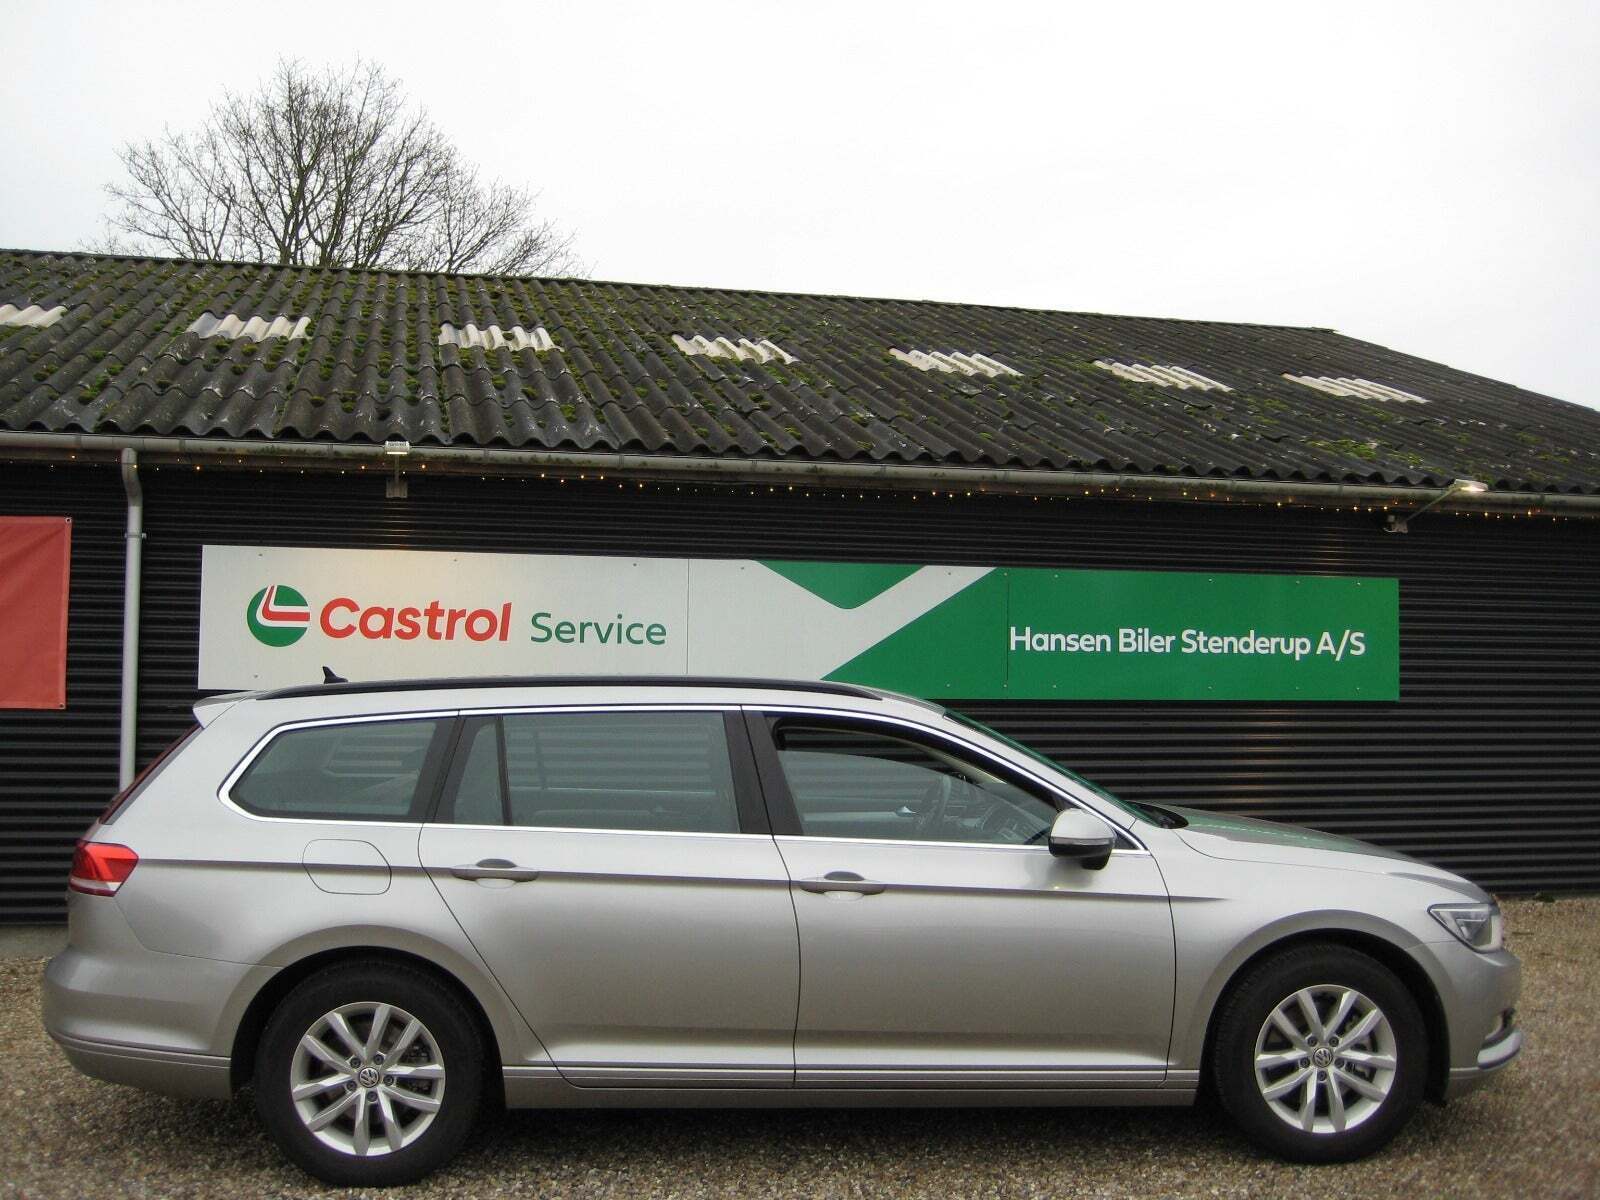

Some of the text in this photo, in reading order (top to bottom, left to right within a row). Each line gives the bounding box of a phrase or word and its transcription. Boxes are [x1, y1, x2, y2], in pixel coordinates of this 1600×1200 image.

[320, 598, 667, 646] Castrol Service
[1010, 626, 1366, 662] Hansen Biler Stenderup A/S
